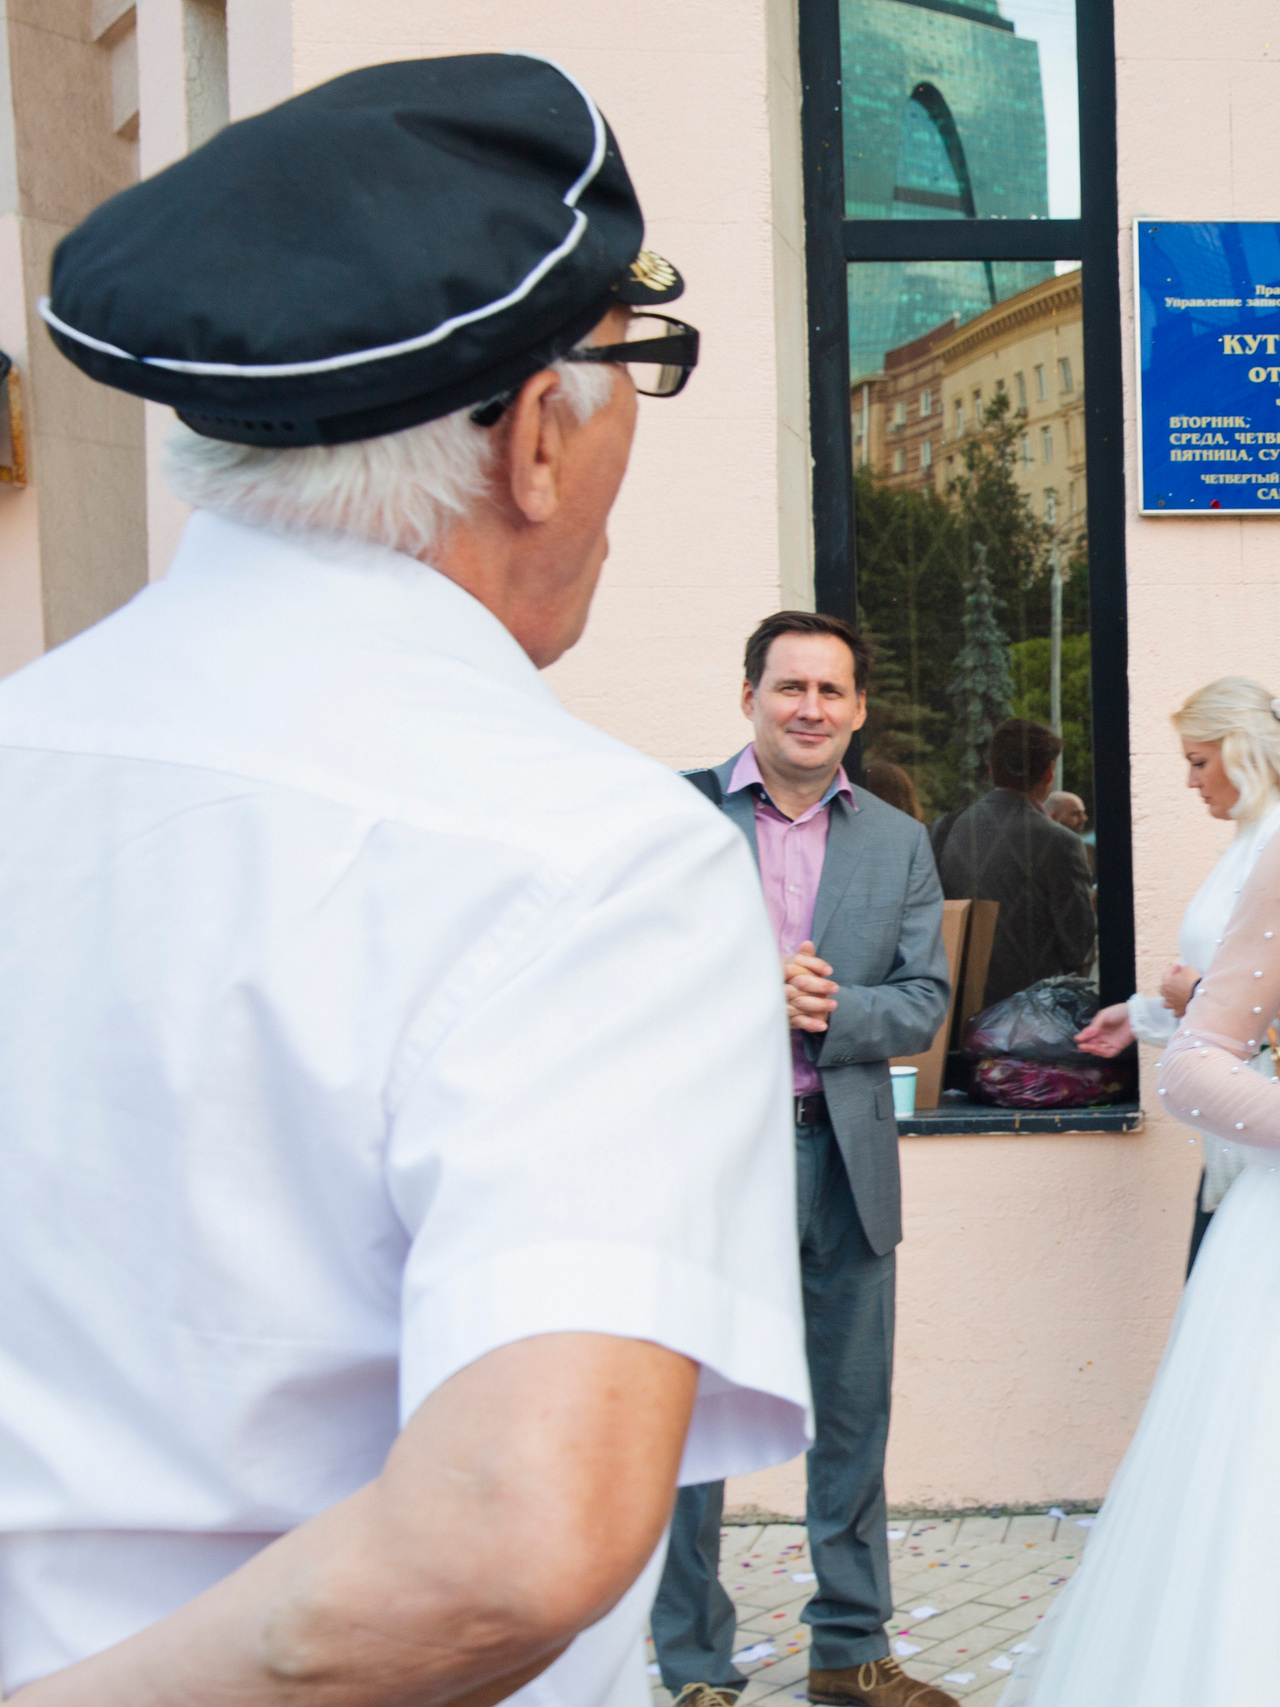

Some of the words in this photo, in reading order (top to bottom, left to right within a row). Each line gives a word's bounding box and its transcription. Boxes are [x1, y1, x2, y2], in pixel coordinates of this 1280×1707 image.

[1164, 298, 1242, 309] Управление
[1170, 416, 1250, 428] ВТОРНИК,
[1169, 433, 1229, 446] СРЕДА,
[1170, 449, 1253, 462] ПЯТНИЦА,
[1200, 472, 1280, 484] ЧЕТВЕРТЫЙ
